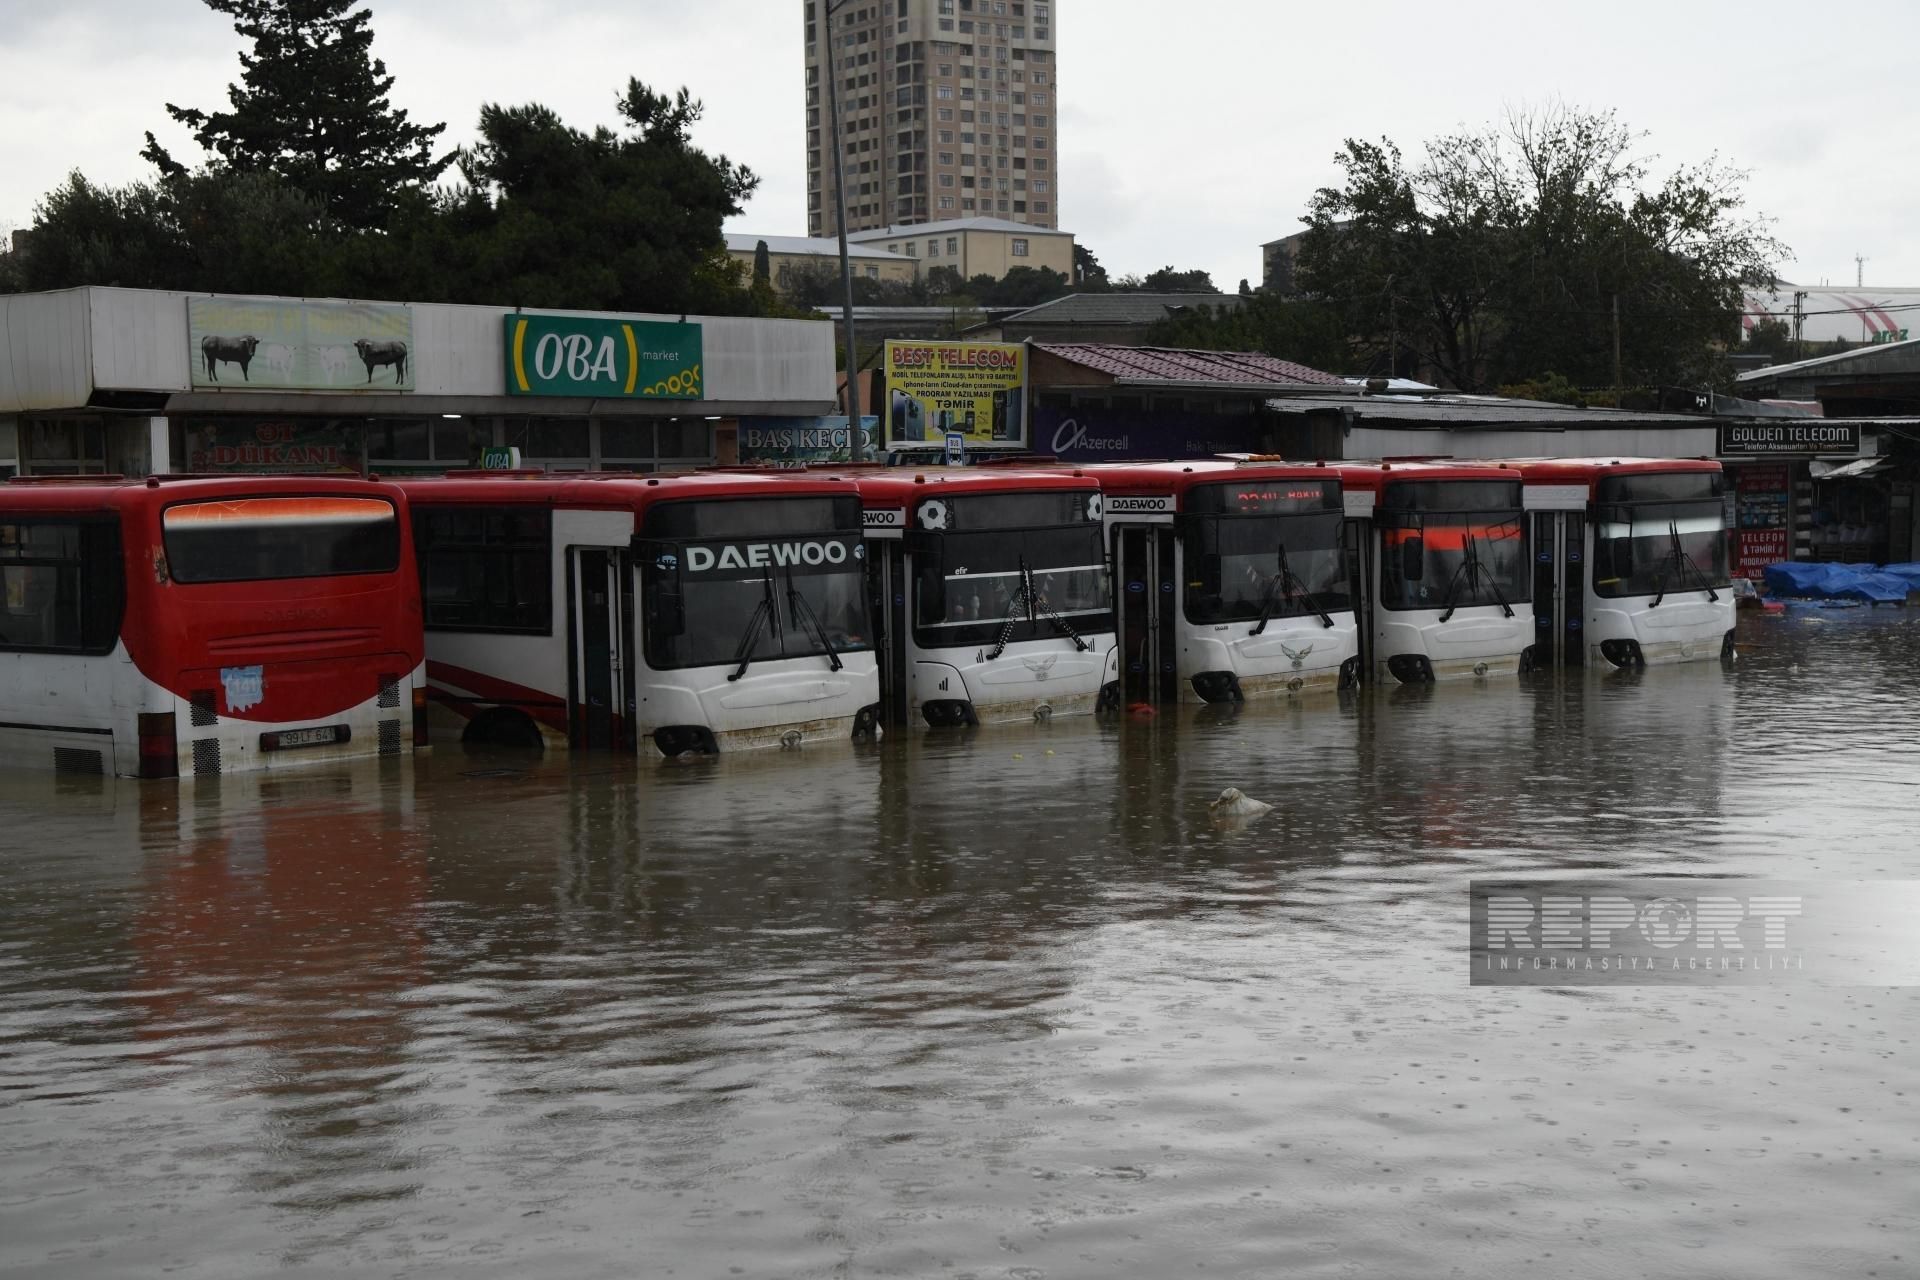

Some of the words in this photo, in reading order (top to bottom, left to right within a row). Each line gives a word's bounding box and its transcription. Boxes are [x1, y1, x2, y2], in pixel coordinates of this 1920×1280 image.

[535, 333, 617, 381] OBA
[643, 350, 679, 361] market
[892, 347, 934, 367] BEST
[938, 348, 1017, 368] TELECOM
[936, 399, 975, 409] TƏMİR
[747, 428, 793, 453] BAŞ
[1732, 427, 1783, 441] GOLDEN
[1788, 427, 1849, 441] TELECOM
[1078, 435, 1128, 450] Azercell
[215, 441, 337, 465] DÜKANI
[485, 453, 509, 469] OBA
[1112, 499, 1166, 509] DAEWOO
[1741, 532, 1785, 542] TELEFON
[686, 541, 847, 572] DAEWOO
